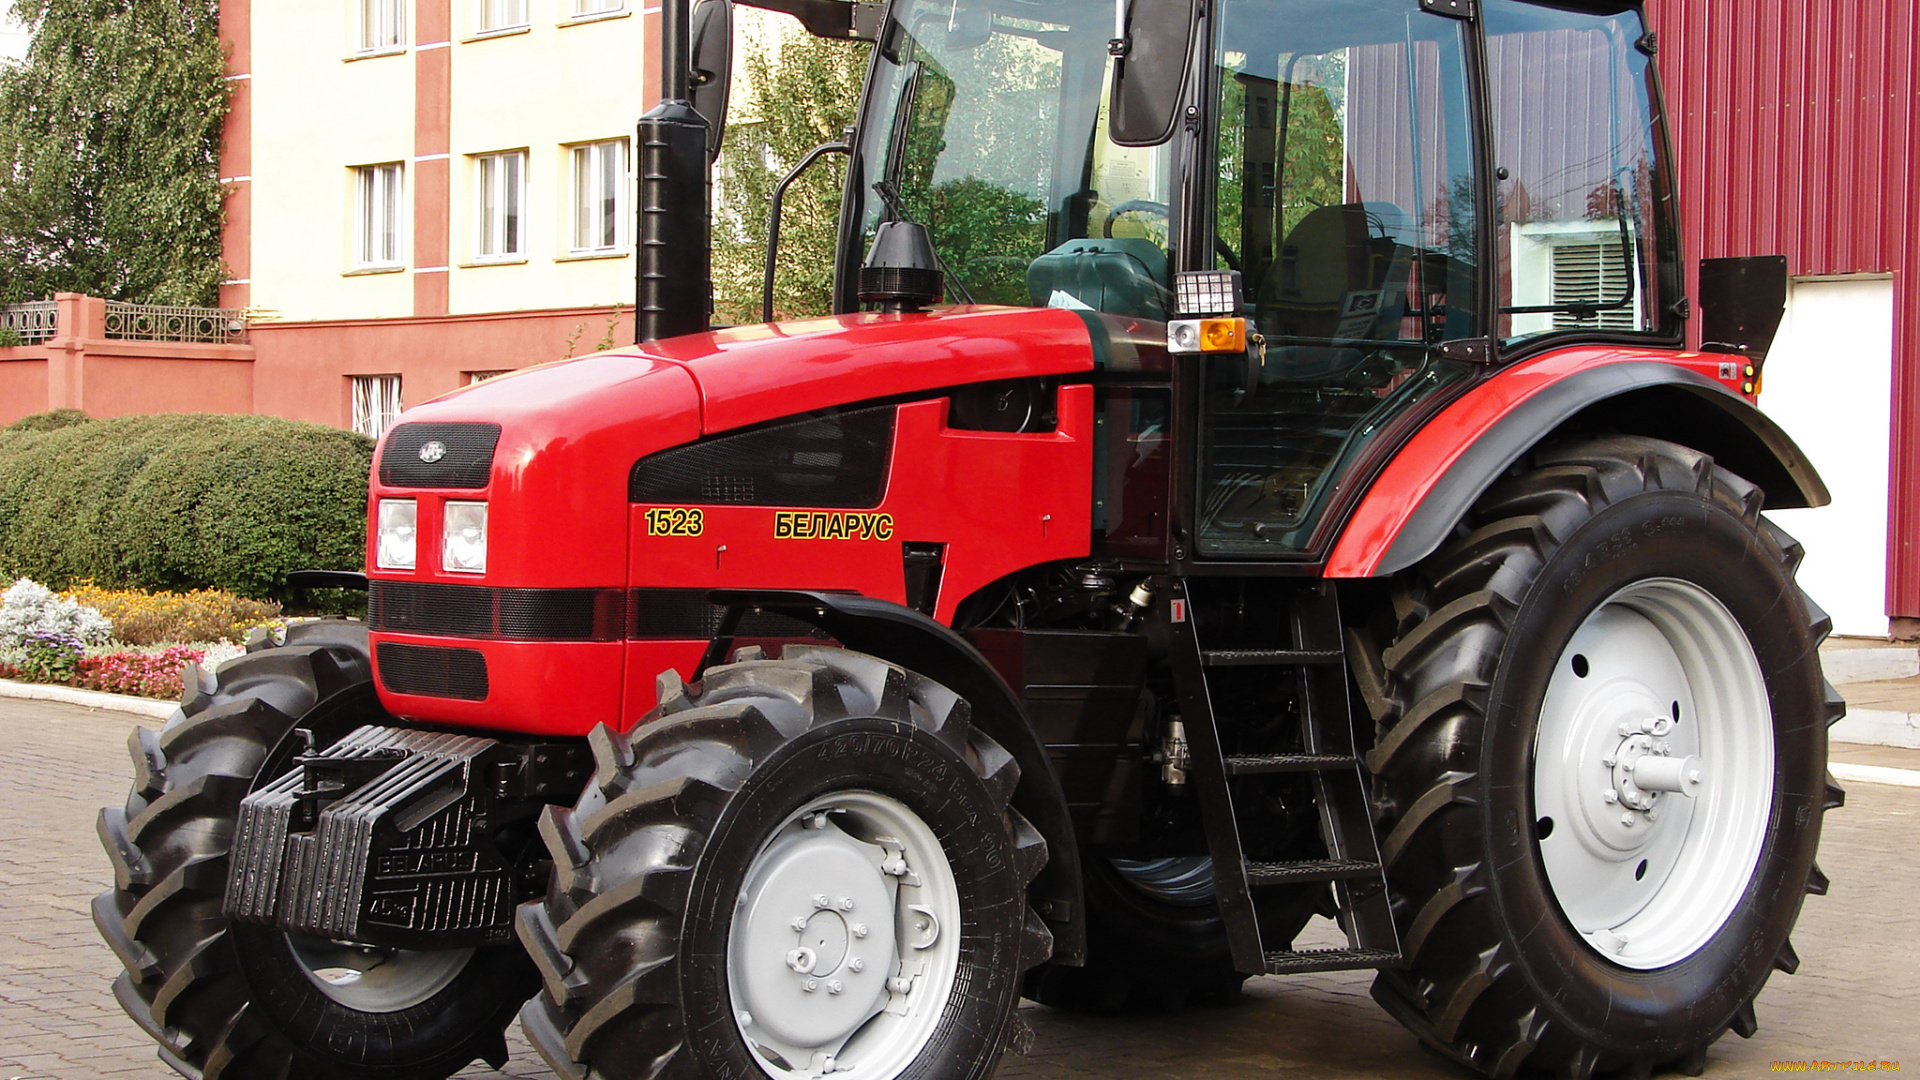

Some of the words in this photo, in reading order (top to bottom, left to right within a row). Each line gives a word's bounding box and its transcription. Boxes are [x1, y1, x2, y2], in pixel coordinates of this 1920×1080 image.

[645, 508, 703, 536] 1523
[774, 512, 893, 540] БЕЛАРУС
[377, 850, 471, 874] BELARUS
